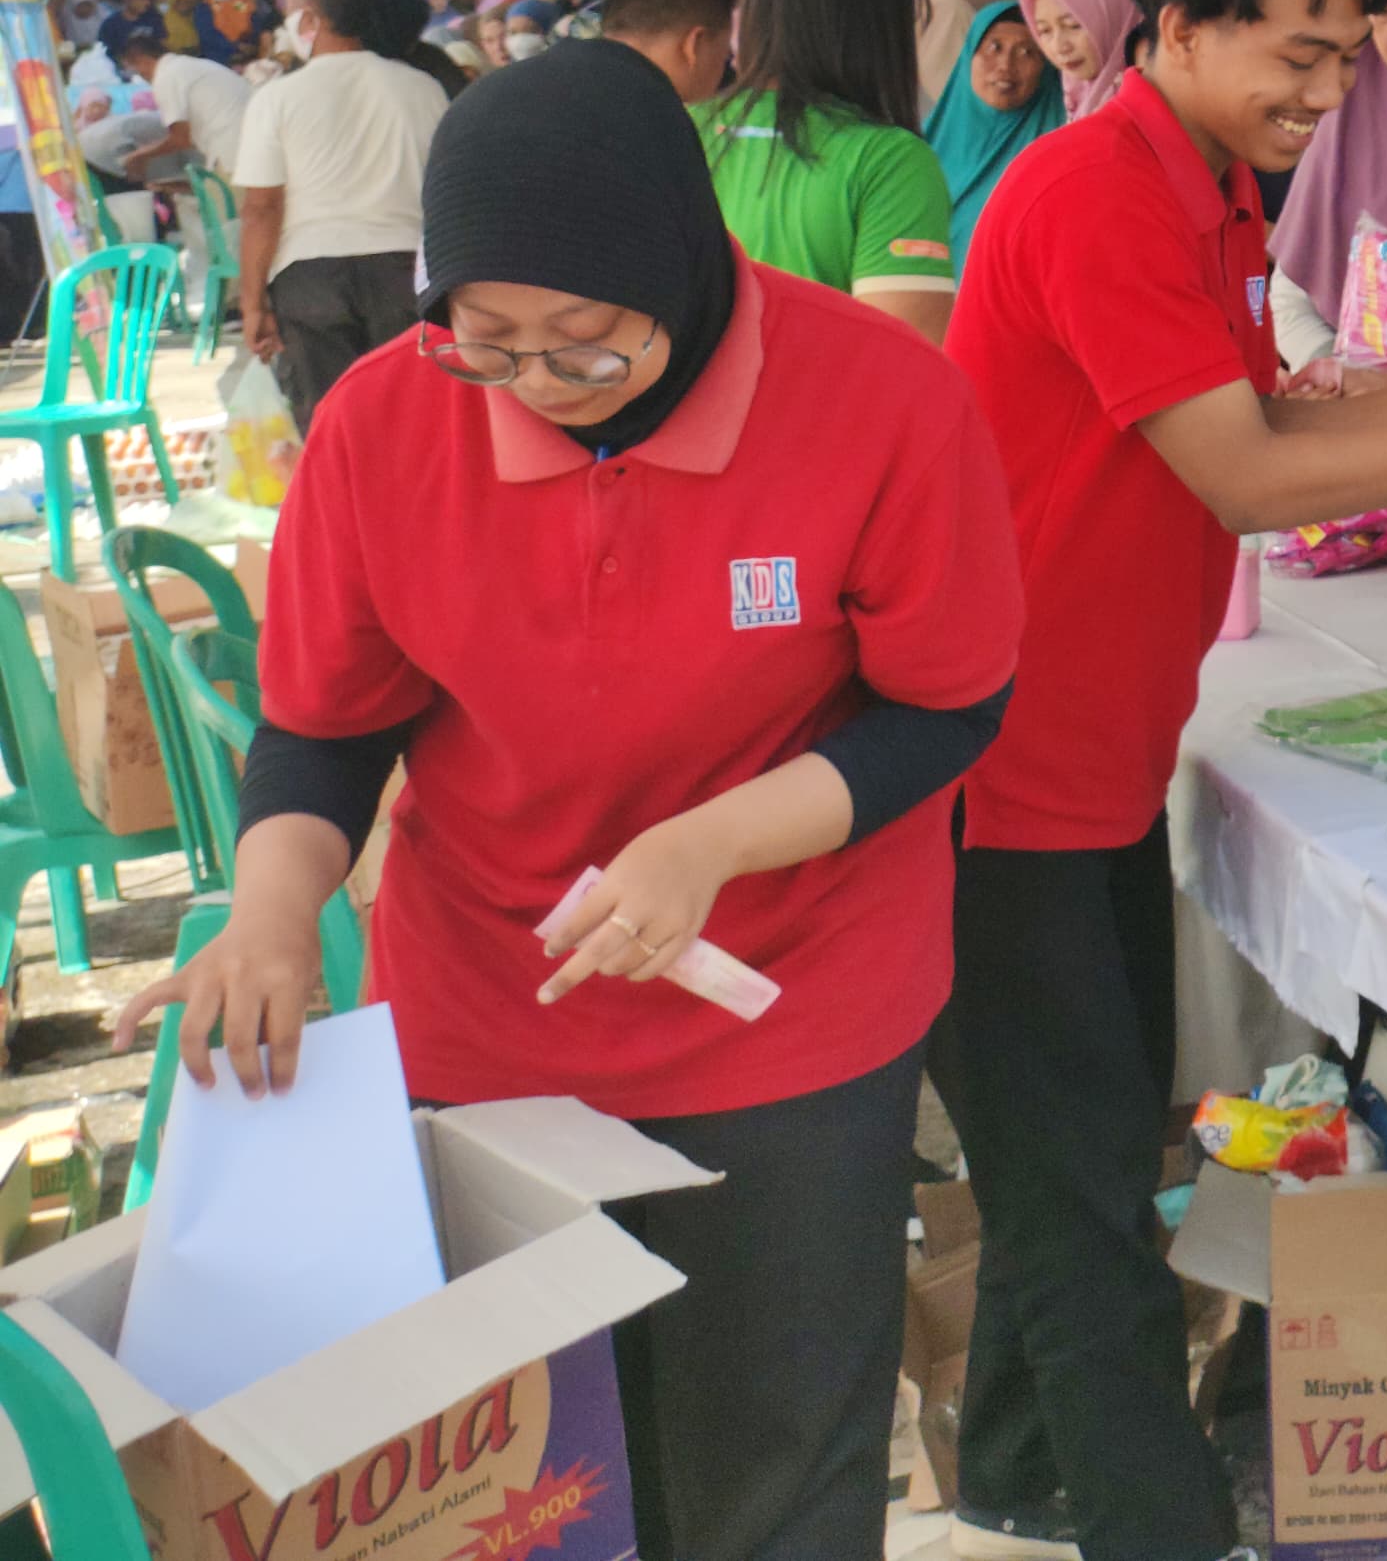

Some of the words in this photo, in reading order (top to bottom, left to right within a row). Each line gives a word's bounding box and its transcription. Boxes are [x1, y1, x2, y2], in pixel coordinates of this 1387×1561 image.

[735, 563, 793, 610] KDS
[1304, 1378, 1374, 1399] Minyak
[372, 1510, 436, 1551] Nabati
[439, 1477, 490, 1514] Alami
